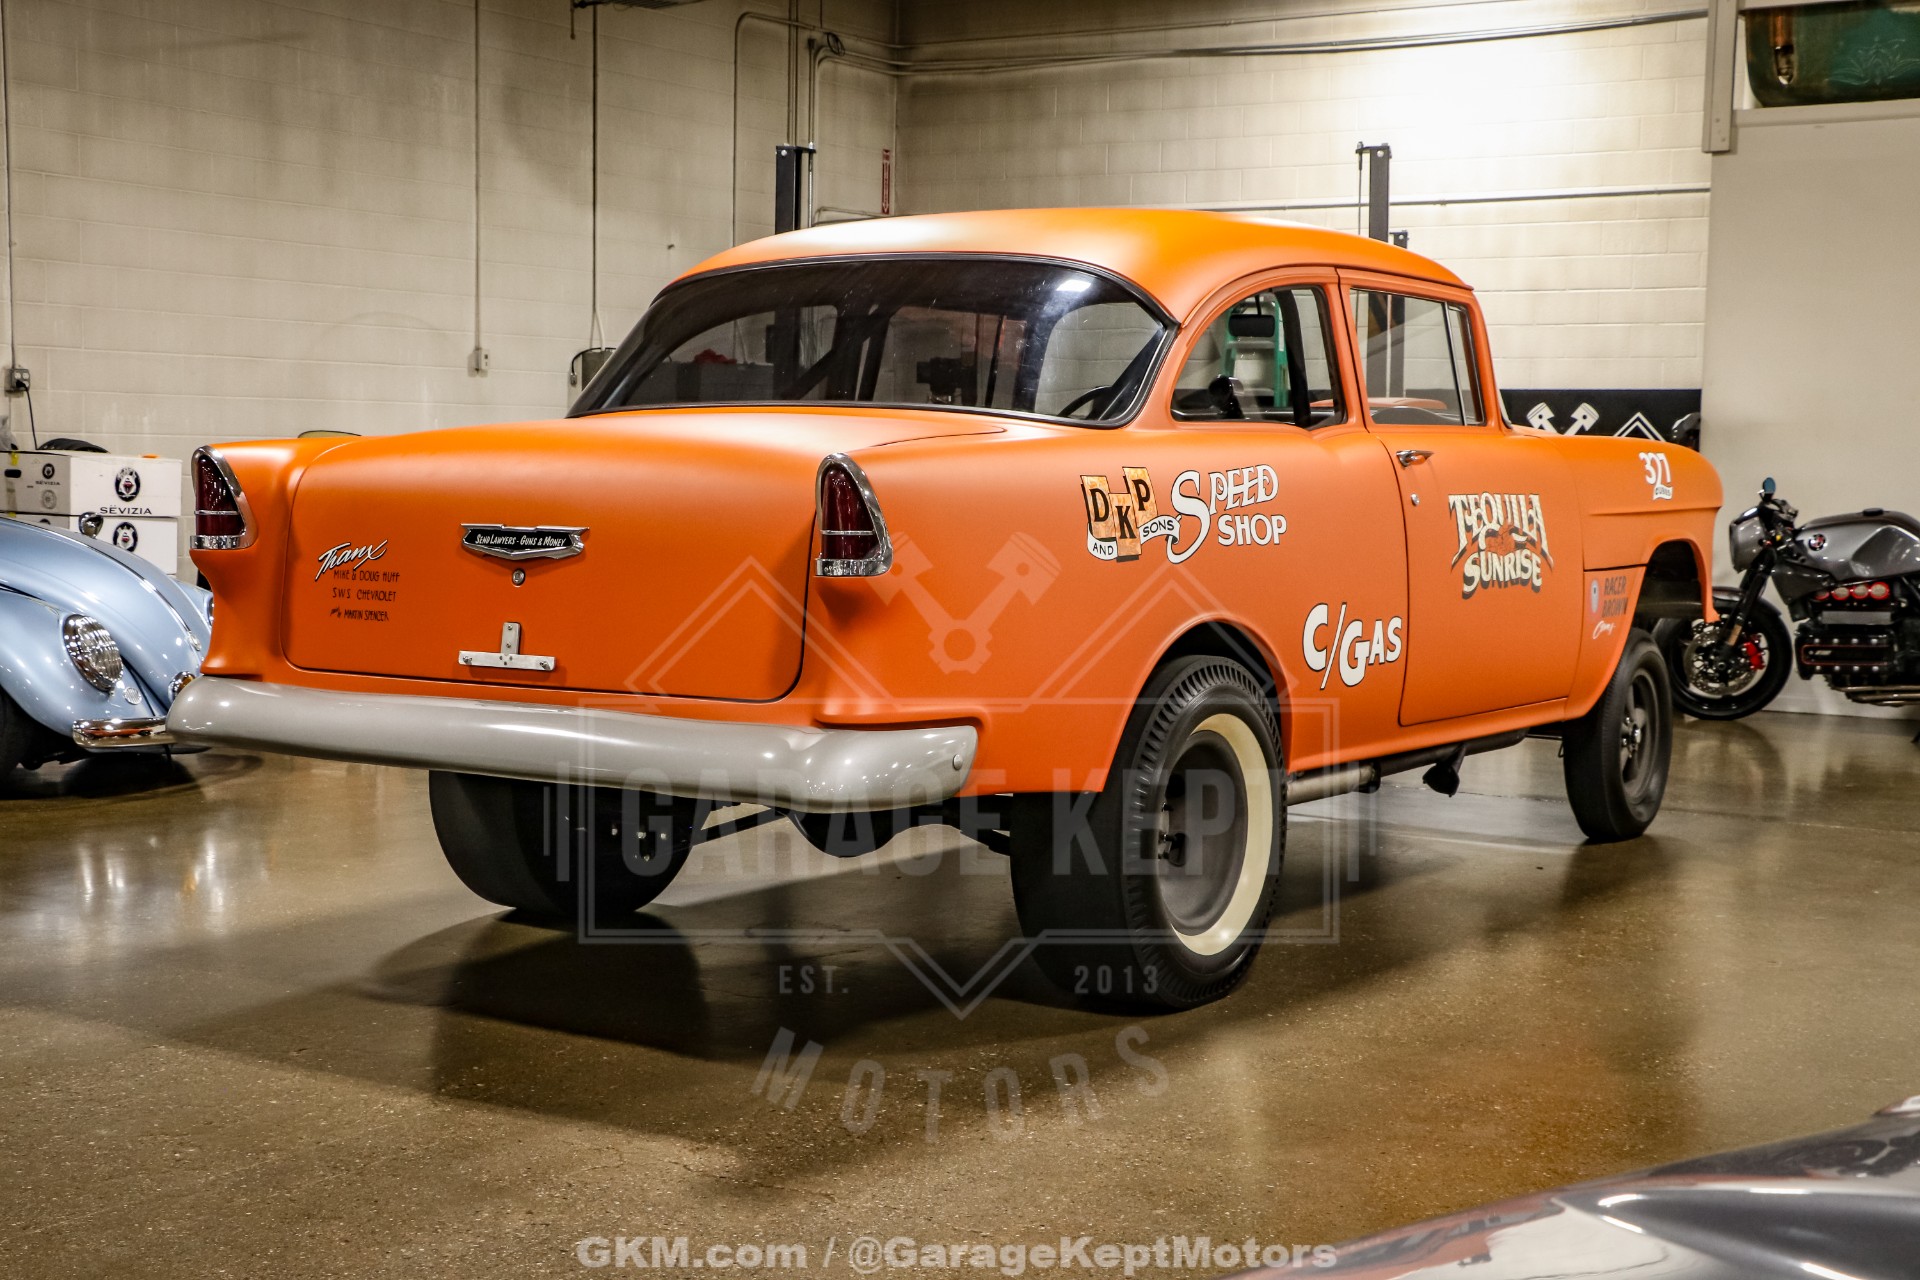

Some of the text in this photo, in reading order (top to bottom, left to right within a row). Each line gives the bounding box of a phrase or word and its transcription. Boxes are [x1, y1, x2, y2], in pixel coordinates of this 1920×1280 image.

[1639, 452, 1671, 490] 327
[1166, 464, 1279, 564] SPEED
[520, 535, 538, 546] GUNS
[543, 536, 567, 547] MONEY
[1142, 519, 1175, 538] SONS
[1217, 513, 1287, 546] SHOP
[1448, 491, 1554, 573] TEQUILA
[1092, 542, 1114, 556] AND
[333, 570, 350, 580] MIKE
[359, 570, 380, 582] DOUG
[1462, 548, 1543, 600] SUNRISE
[1604, 576, 1627, 596] RACER
[356, 589, 397, 602] CHEVROLET
[1302, 602, 1402, 691] C/GAS
